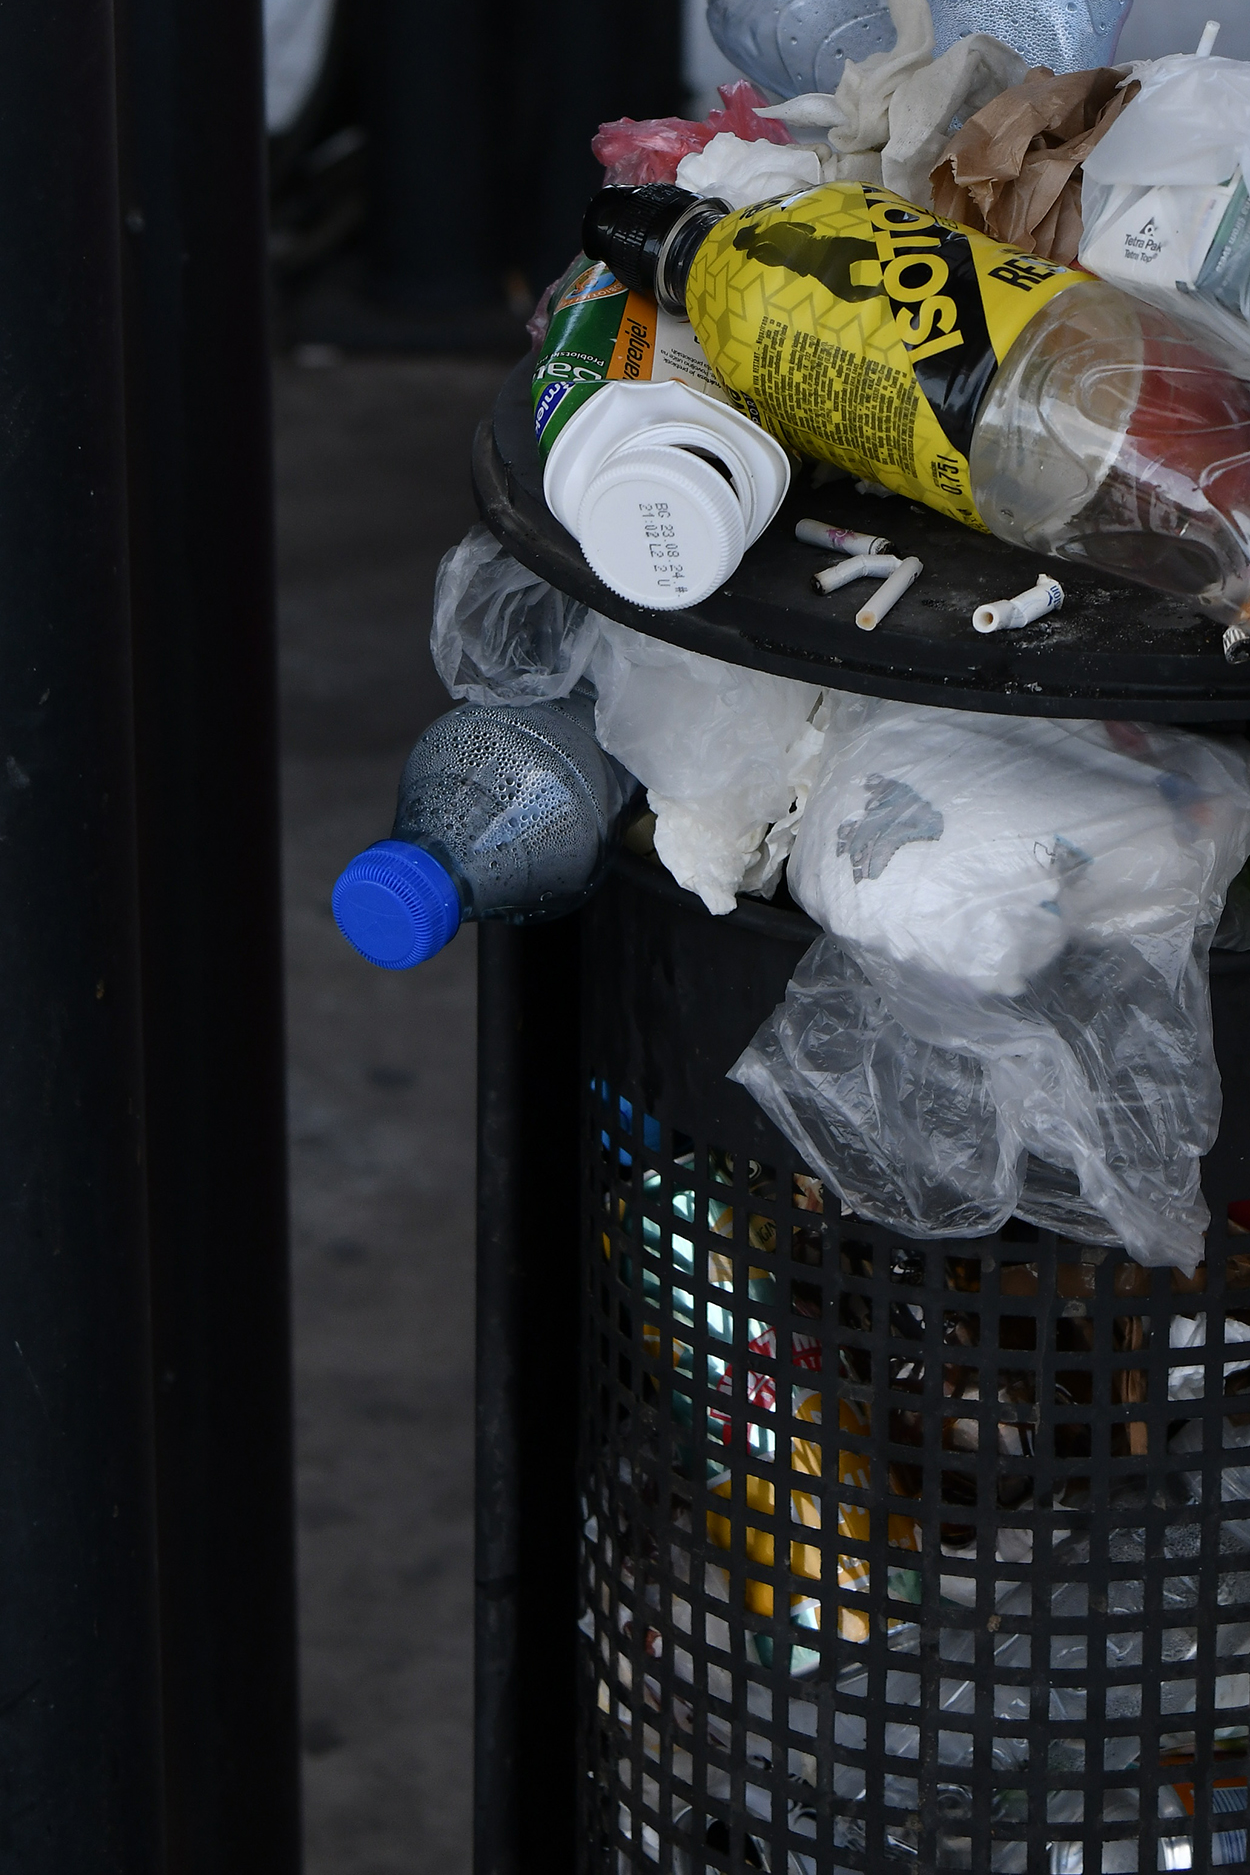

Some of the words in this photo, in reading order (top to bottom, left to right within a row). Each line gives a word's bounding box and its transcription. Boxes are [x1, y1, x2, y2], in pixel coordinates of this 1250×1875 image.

[1124, 234, 1144, 248] Tetra
[1145, 238, 1163, 252] Pak
[1124, 249, 1139, 260] Tetra
[552, 351, 605, 366] Probiotski
[654, 502, 671, 518] BG
[638, 503, 660, 538] 21:02
[649, 543, 665, 558] L2
